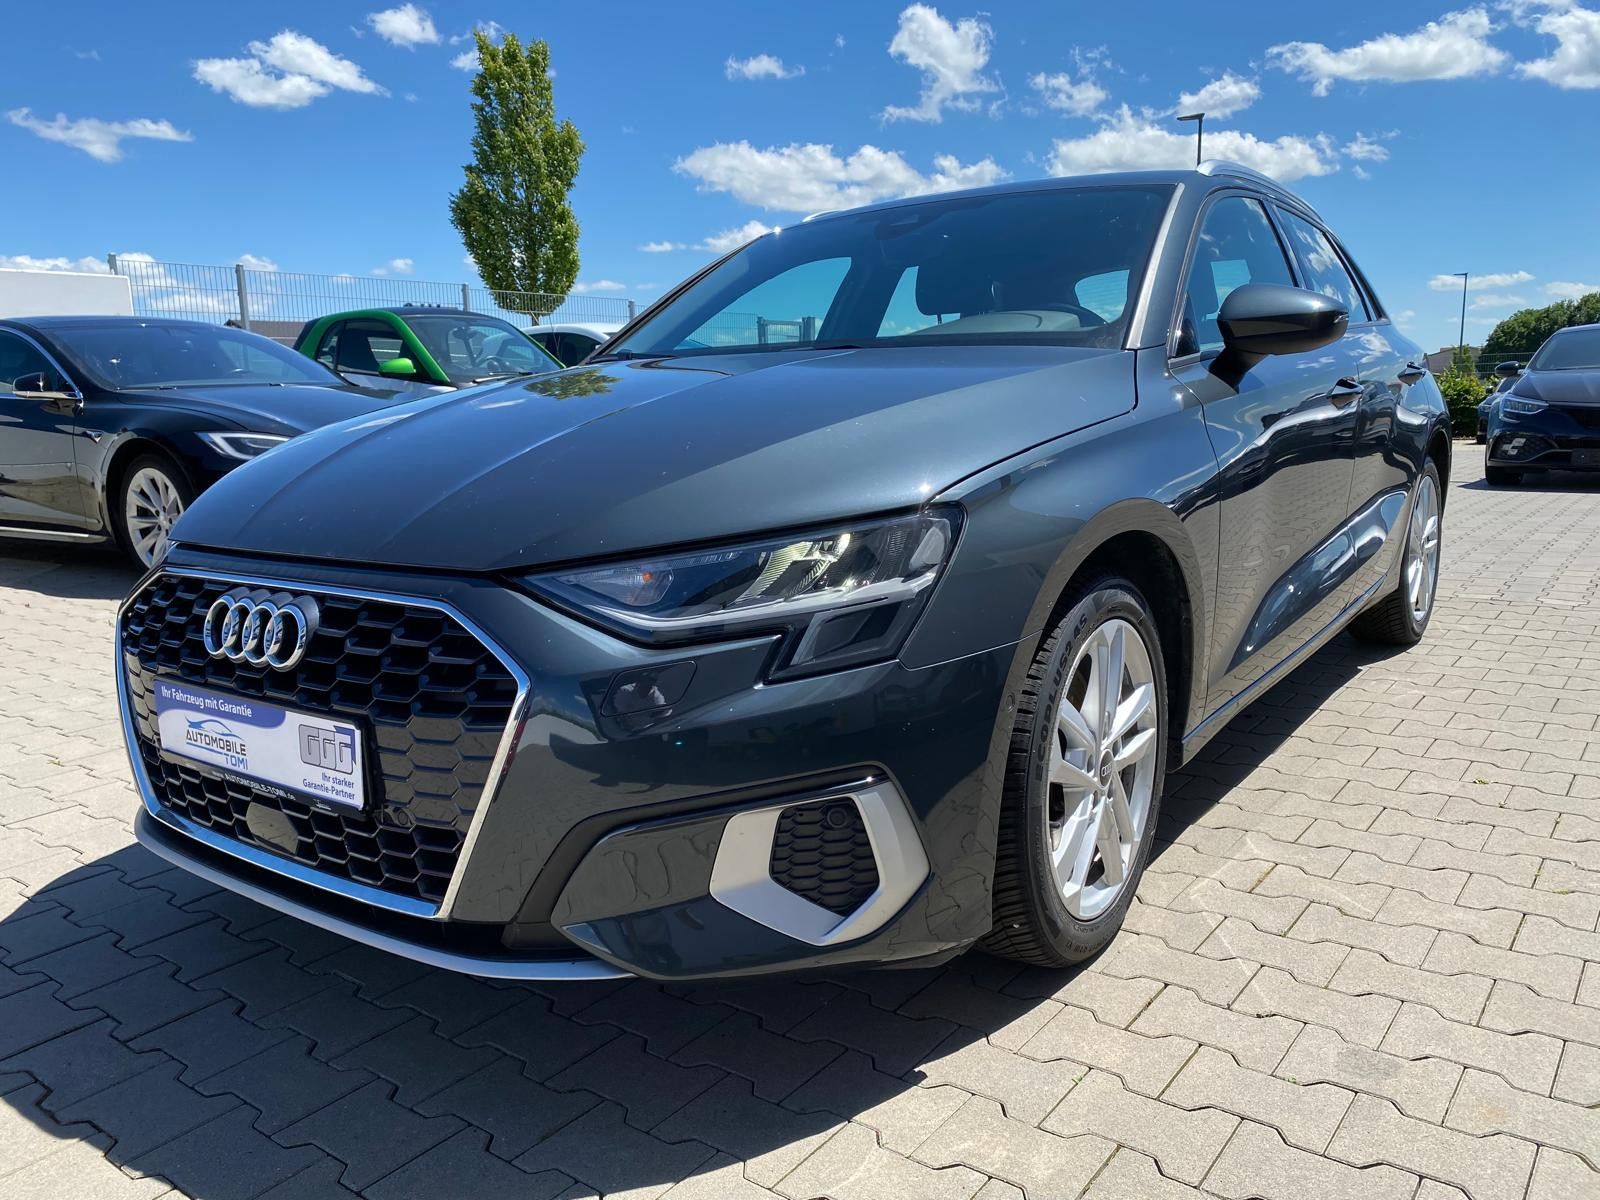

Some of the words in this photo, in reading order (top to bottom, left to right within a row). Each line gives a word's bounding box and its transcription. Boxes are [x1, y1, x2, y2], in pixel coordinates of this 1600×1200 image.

[161, 686, 171, 698] Ihr
[172, 688, 205, 709] Fahrzeug
[205, 697, 218, 709] mit
[218, 700, 253, 717] Garantie
[186, 729, 247, 756] AUTOMOBILE
[223, 752, 249, 770] TOMI
[303, 779, 355, 800] Garantie-Partner
[321, 772, 331, 782] Ihr
[331, 776, 355, 789] starker
